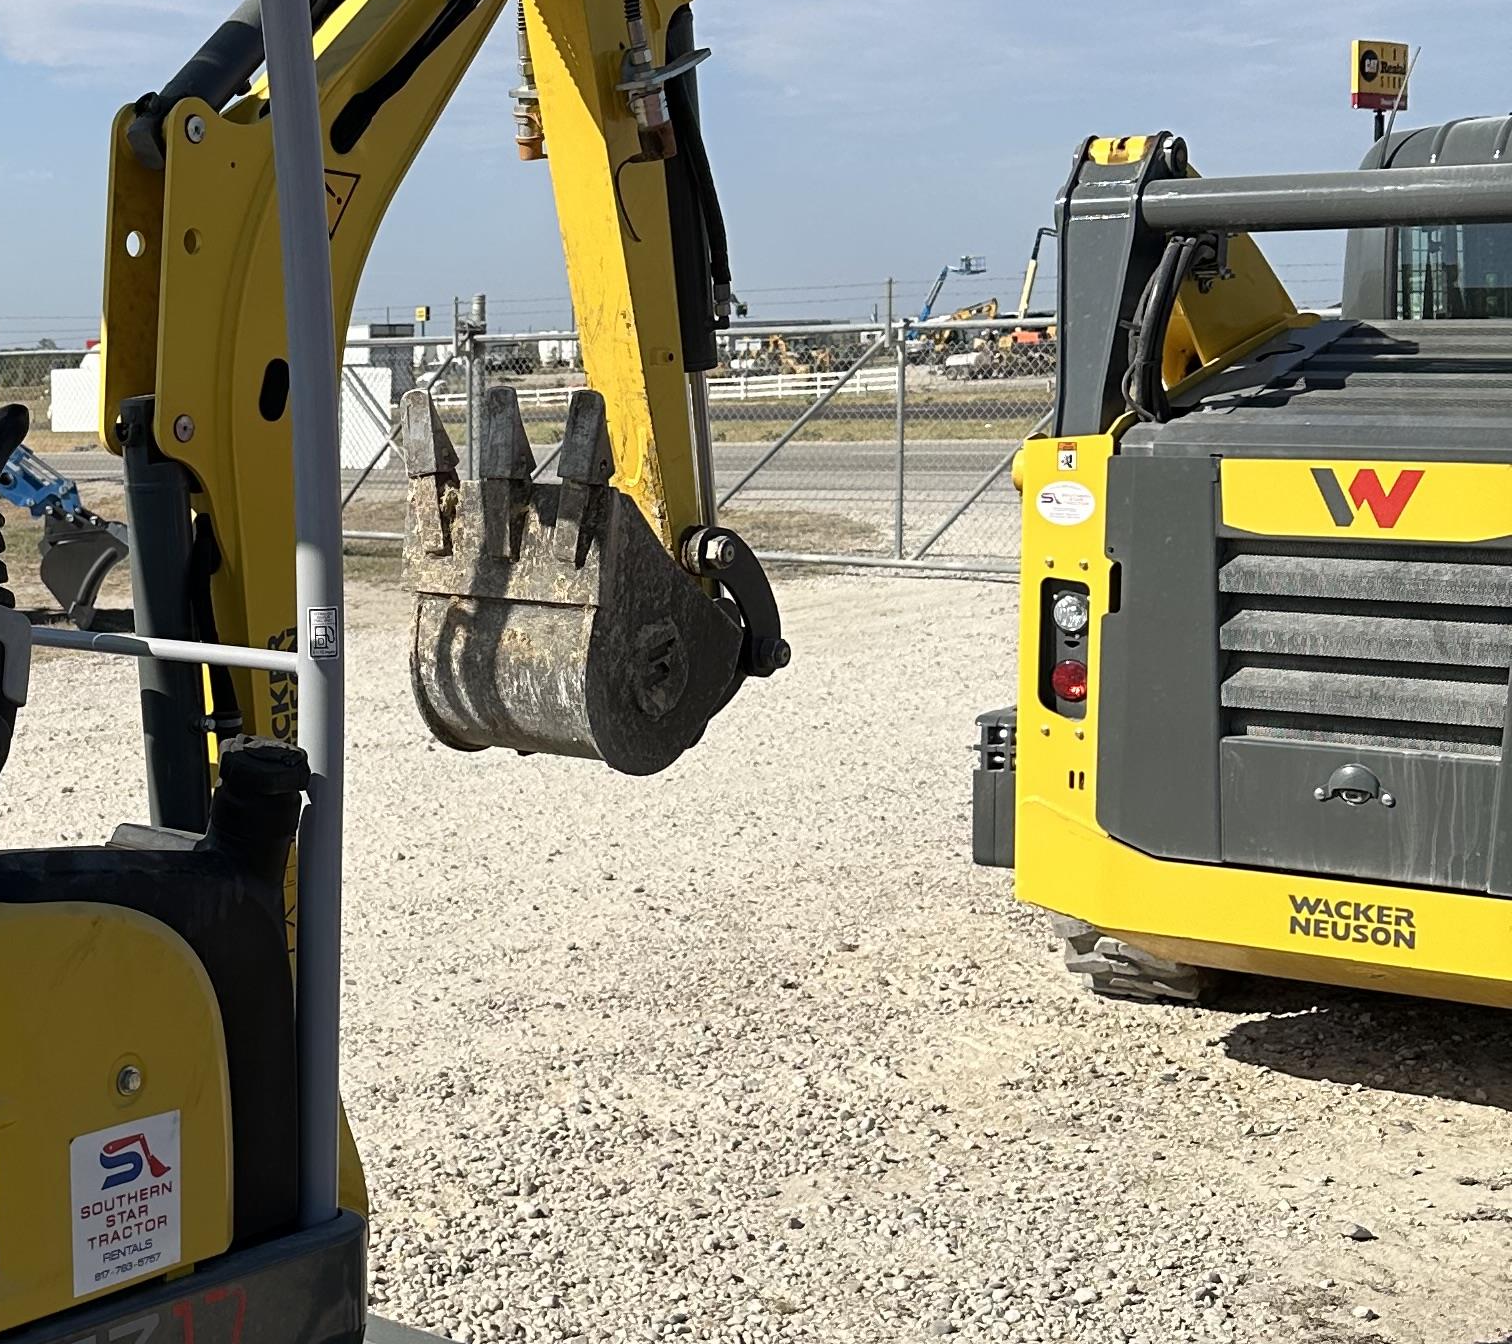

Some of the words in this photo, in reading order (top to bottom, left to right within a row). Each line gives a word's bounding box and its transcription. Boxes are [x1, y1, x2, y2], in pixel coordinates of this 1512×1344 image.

[268, 630, 290, 745] CKER
[1288, 894, 1416, 928] WACKER
[1290, 915, 1416, 950] NEUSON
[80, 1181, 173, 1220] SOUTHERN
[106, 1204, 149, 1228] STAR
[87, 1215, 168, 1251] TRACTOR
[102, 1238, 153, 1264] RENTALS
